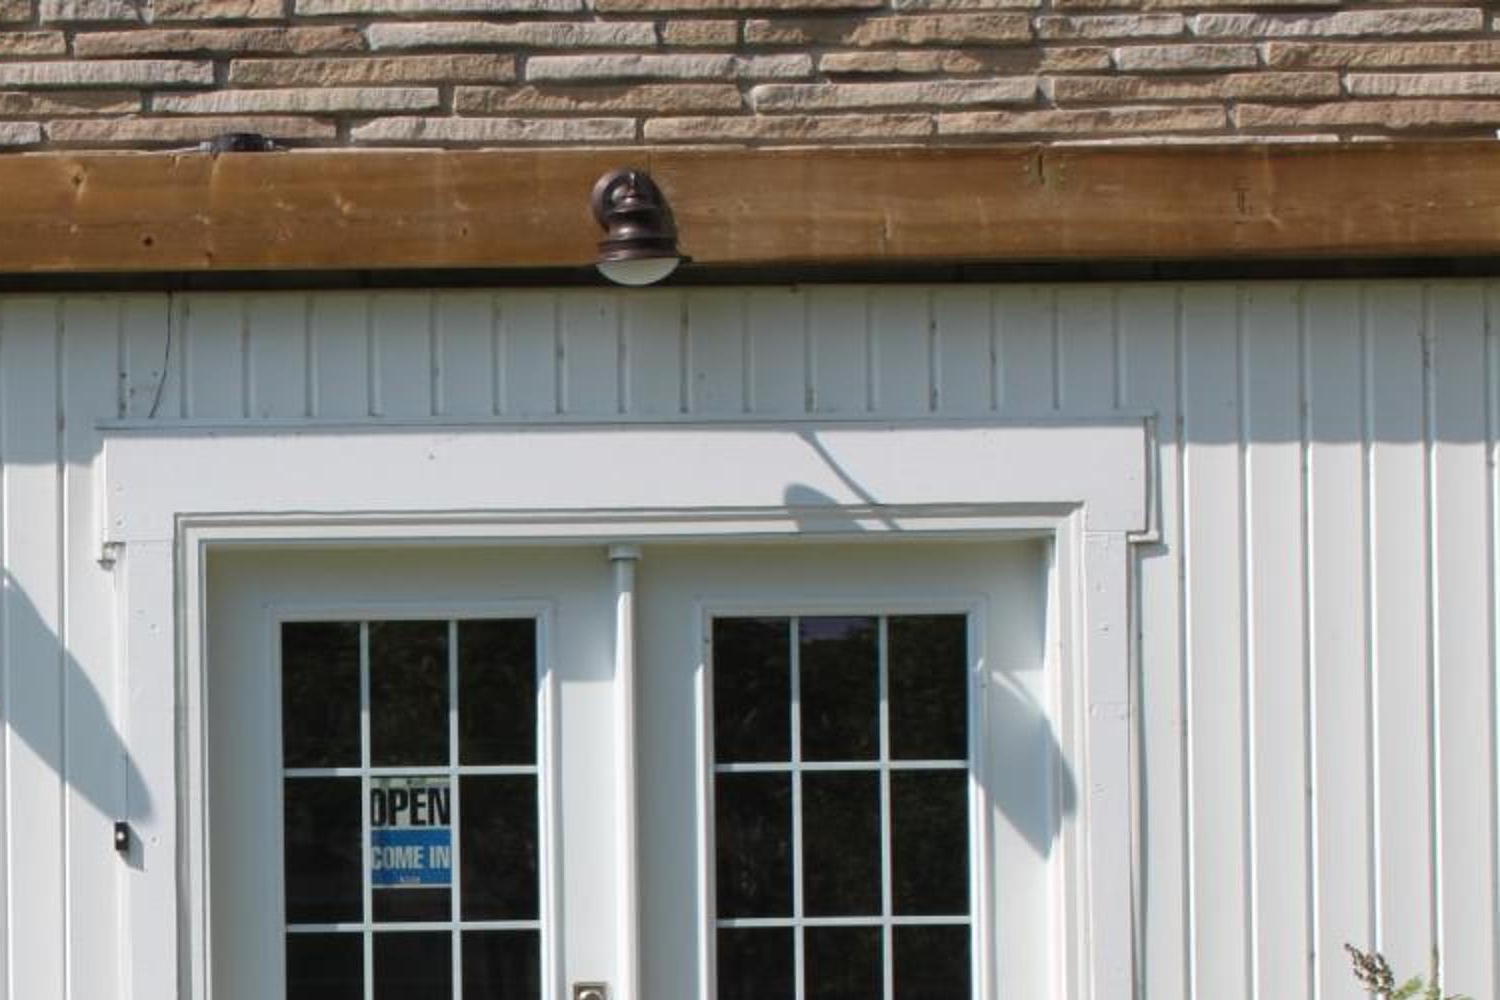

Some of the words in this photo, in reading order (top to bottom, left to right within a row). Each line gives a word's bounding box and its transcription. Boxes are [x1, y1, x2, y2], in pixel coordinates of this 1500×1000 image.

[371, 787, 451, 826] OPEN
[371, 845, 424, 869] COME
[429, 845, 451, 869] IN
